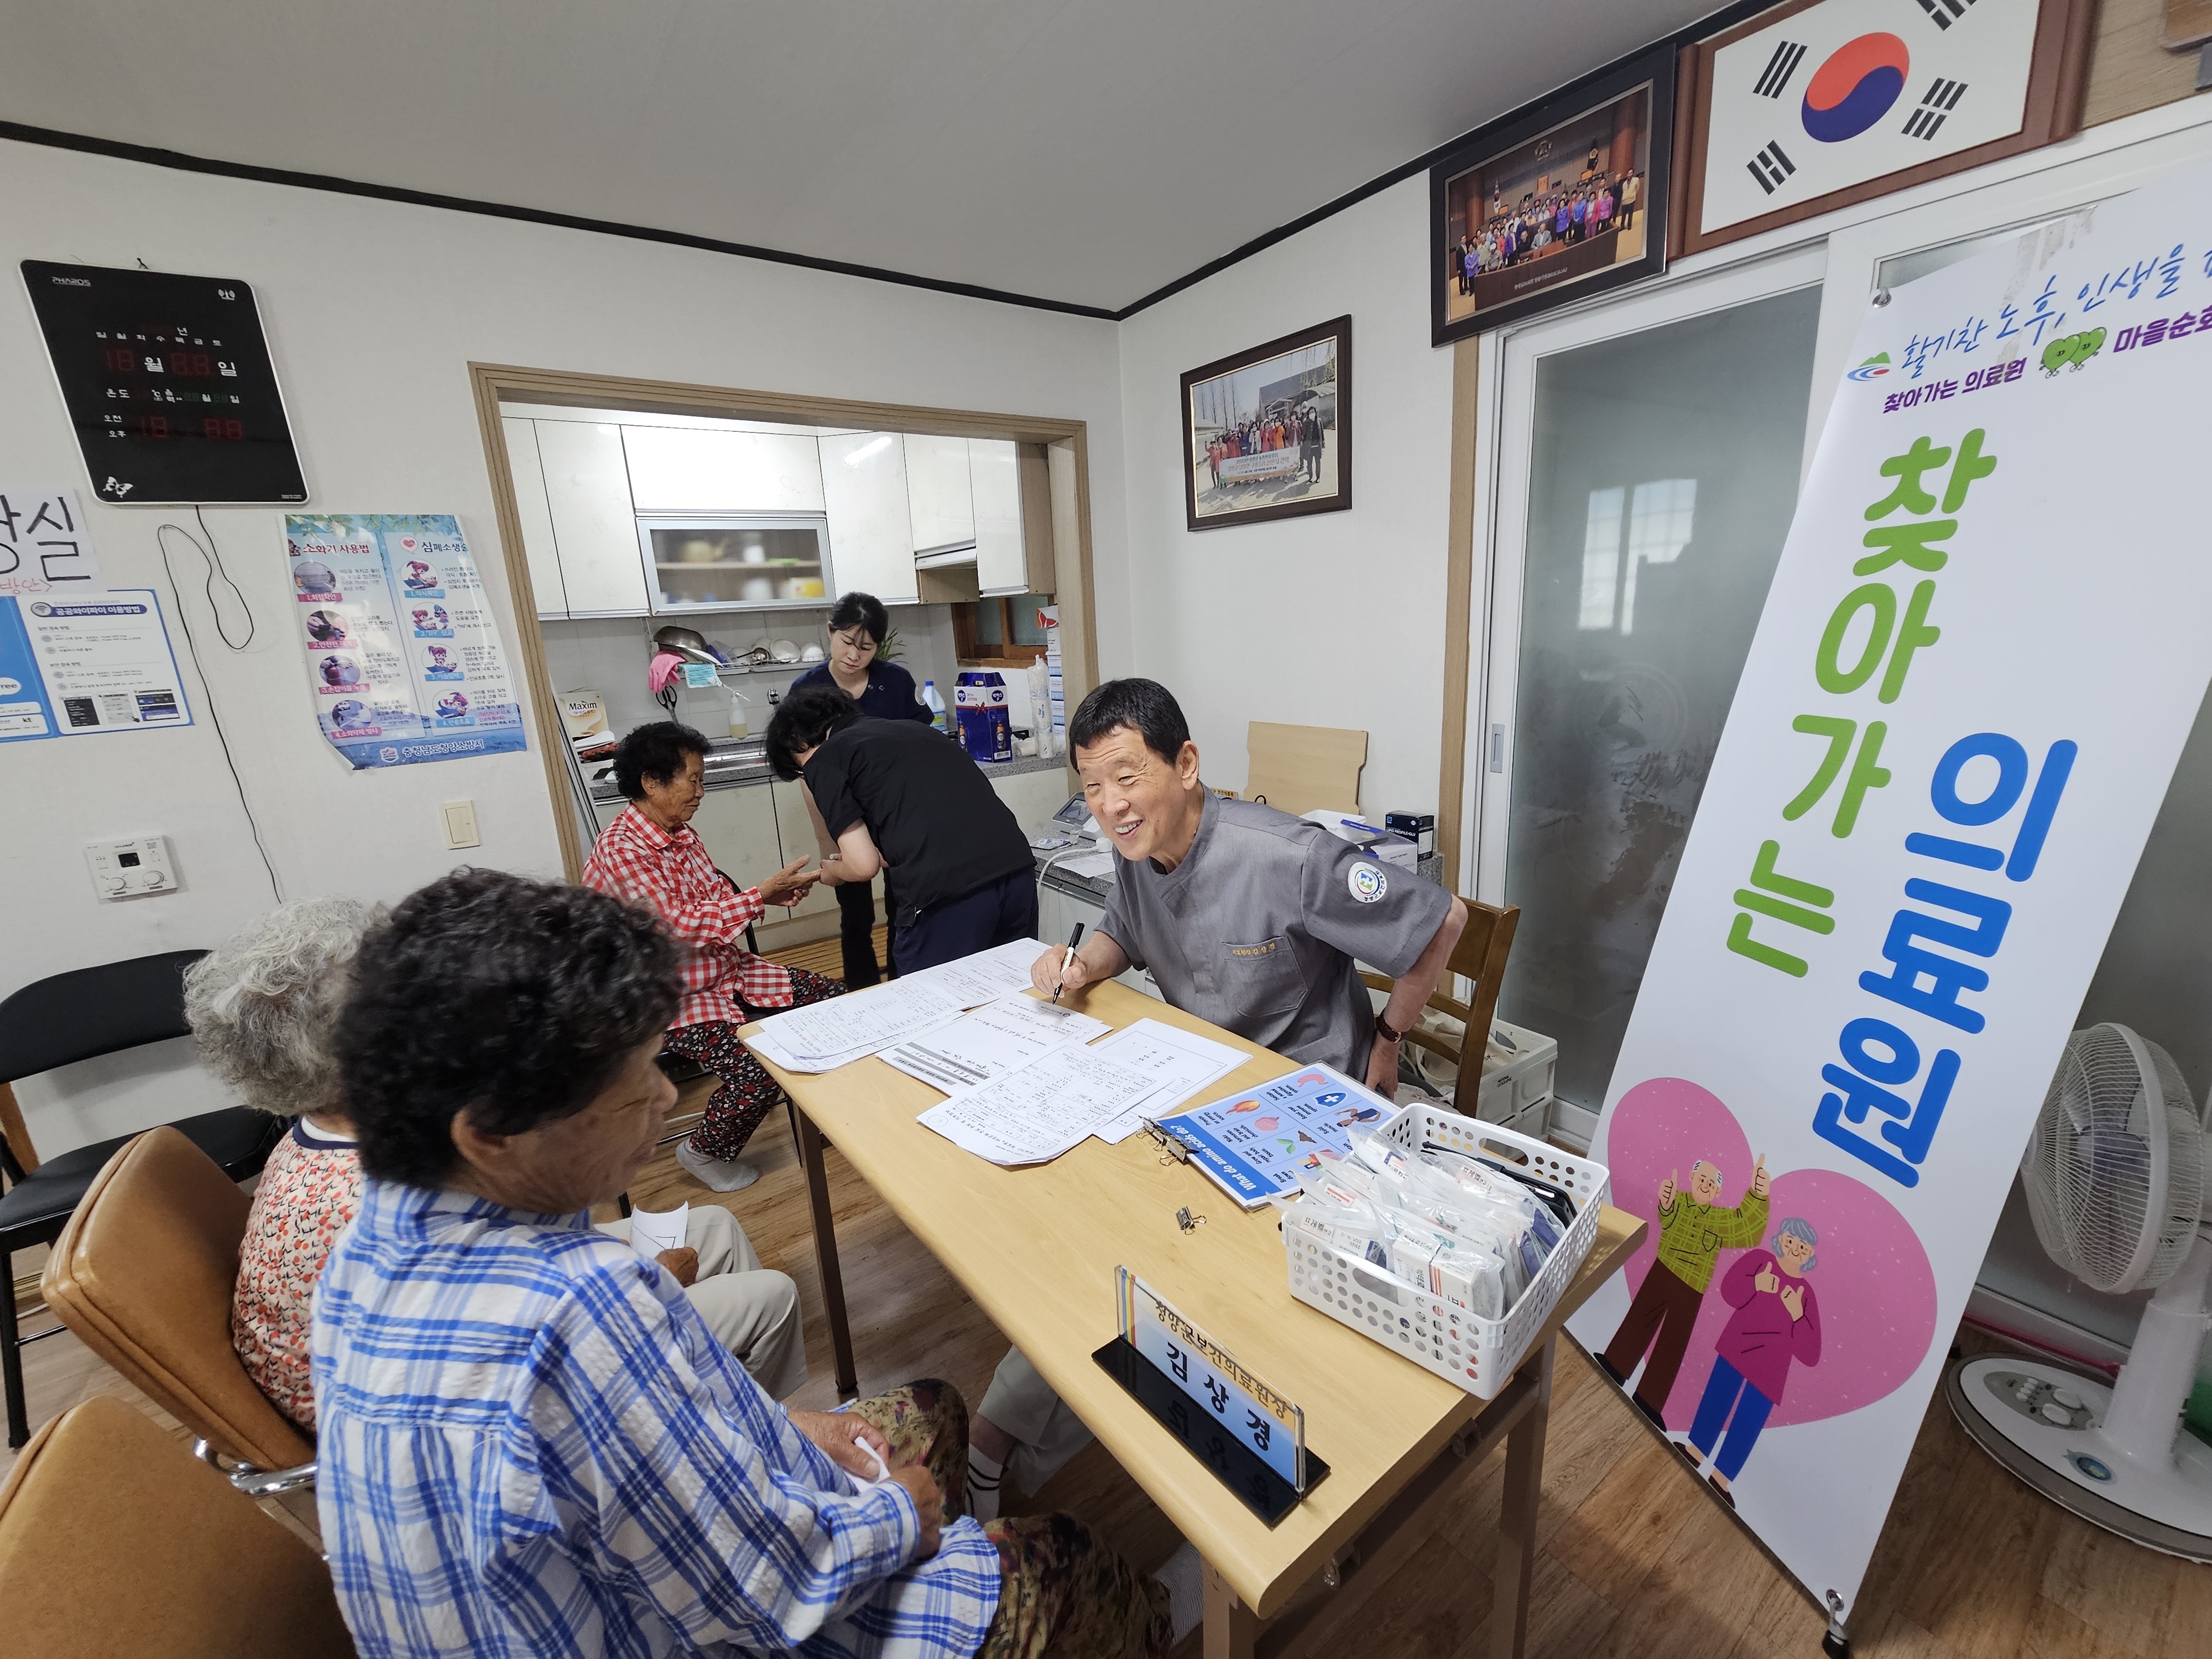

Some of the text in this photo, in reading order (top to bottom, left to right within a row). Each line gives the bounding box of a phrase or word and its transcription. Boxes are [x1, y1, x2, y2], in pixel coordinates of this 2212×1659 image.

[1902, 316, 1989, 380] 활기찬
[1996, 274, 2066, 346] 노후,
[2077, 243, 2187, 313] 인생을
[144, 357, 164, 372] 월
[218, 361, 237, 377] 일
[106, 388, 131, 398] 온도
[1883, 357, 2028, 415] 찾아가는 의료원
[303, 543, 369, 554] 소화기 사용법
[421, 541, 469, 552] 심폐소생술
[55, 604, 142, 616] 공공와이파이 이용방법
[569, 700, 597, 711] Maxim
[1726, 428, 1997, 978] 찾아가는
[401, 739, 484, 758] 충청남도청양소방서
[1812, 732, 2078, 1189] 의료원
[1287, 1106, 1308, 1120] Boost your
[1198, 1115, 1212, 1126] Provide
[1226, 1129, 1244, 1143] hormones
[1240, 1124, 1259, 1139] chemicals.
[1317, 1126, 1330, 1135] Build
[1222, 1134, 1234, 1143] Make
[1170, 1125, 1257, 1191] What do amino acids do?
[1249, 1147, 1271, 1164] repair body
[1251, 1155, 1262, 1165] Grow
[1272, 1173, 1287, 1183] Break
[1281, 1171, 1294, 1180] down
[1155, 1300, 1288, 1420] 청양군보건의료원장
[1166, 1341, 1271, 1452] 김상경
